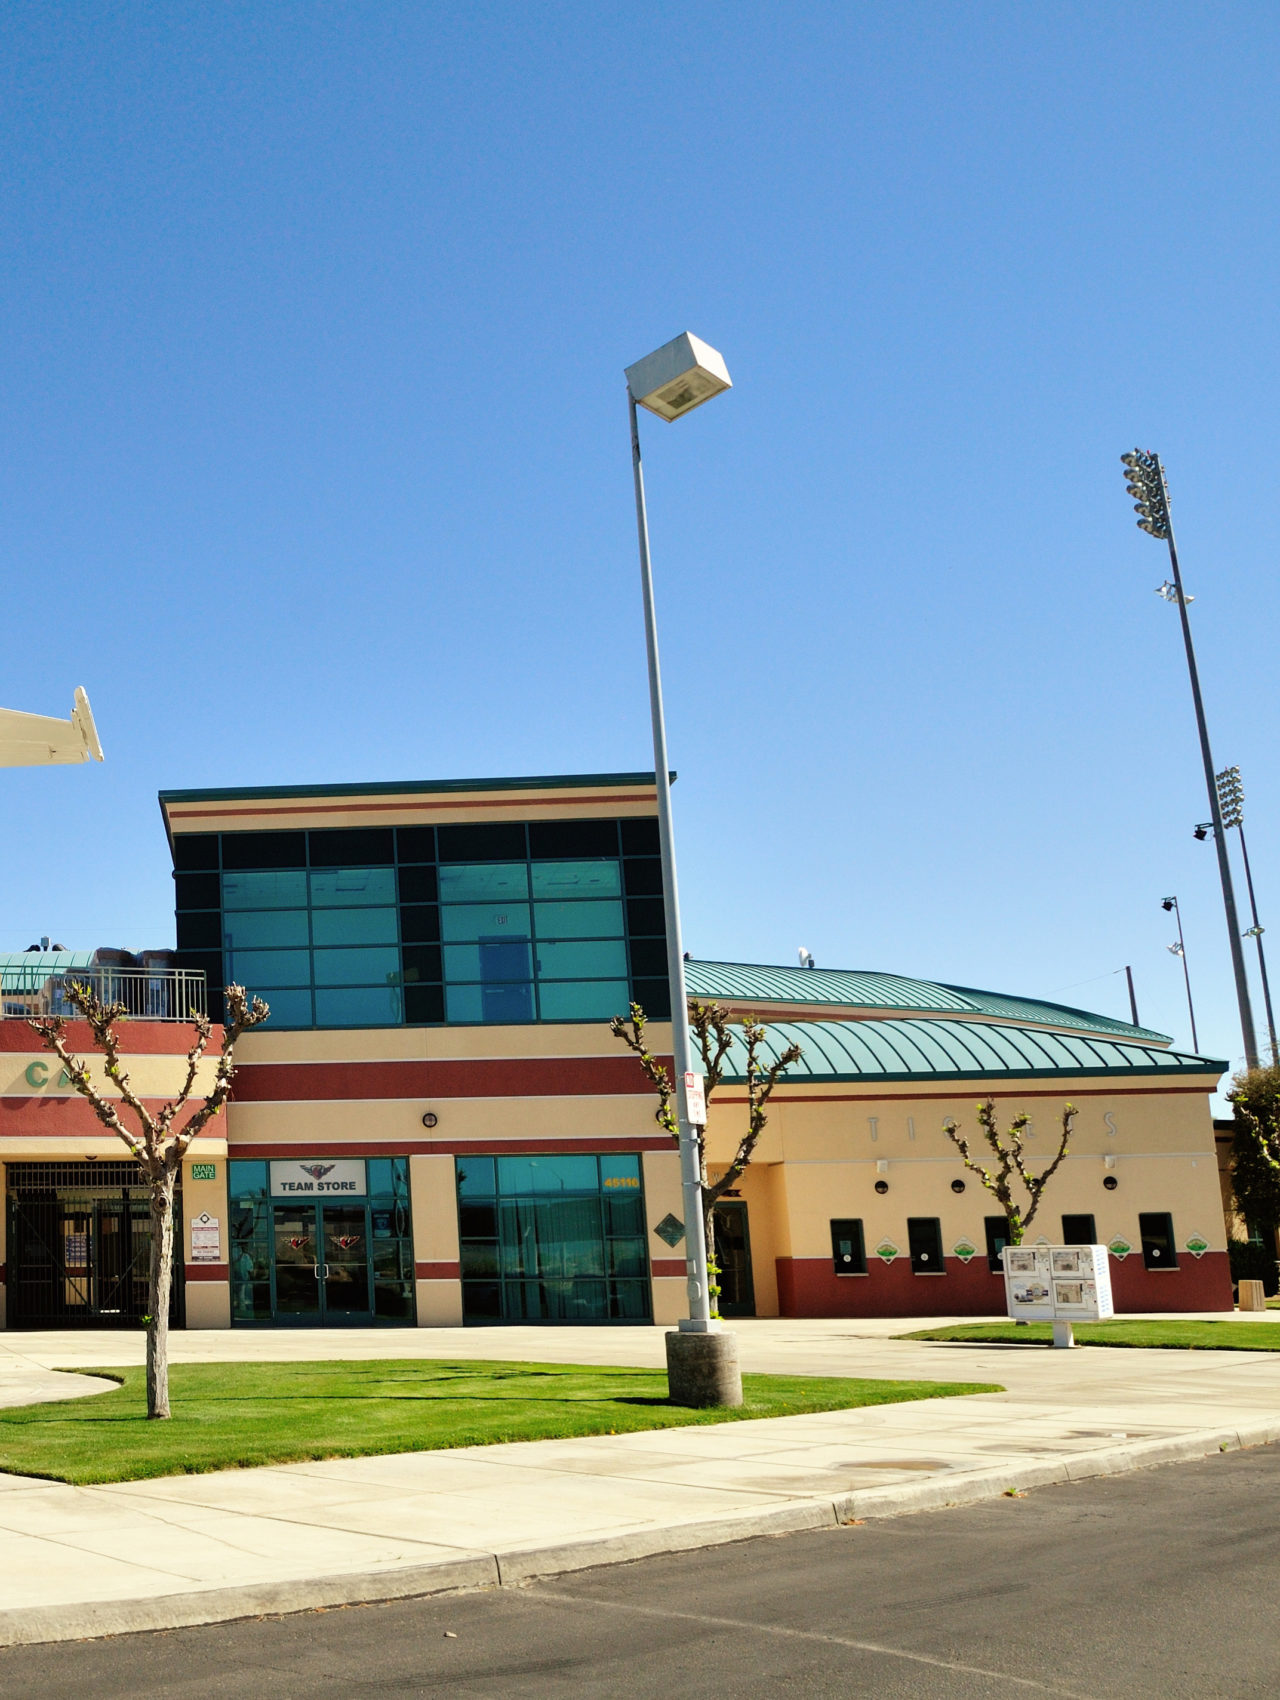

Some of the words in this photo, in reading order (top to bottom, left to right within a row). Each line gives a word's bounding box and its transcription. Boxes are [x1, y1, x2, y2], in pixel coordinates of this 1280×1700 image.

[867, 1112, 1117, 1141] TICETS
[193, 1171, 215, 1179] GATE
[280, 1182, 313, 1191] TEAM
[317, 1181, 356, 1191] STORE
